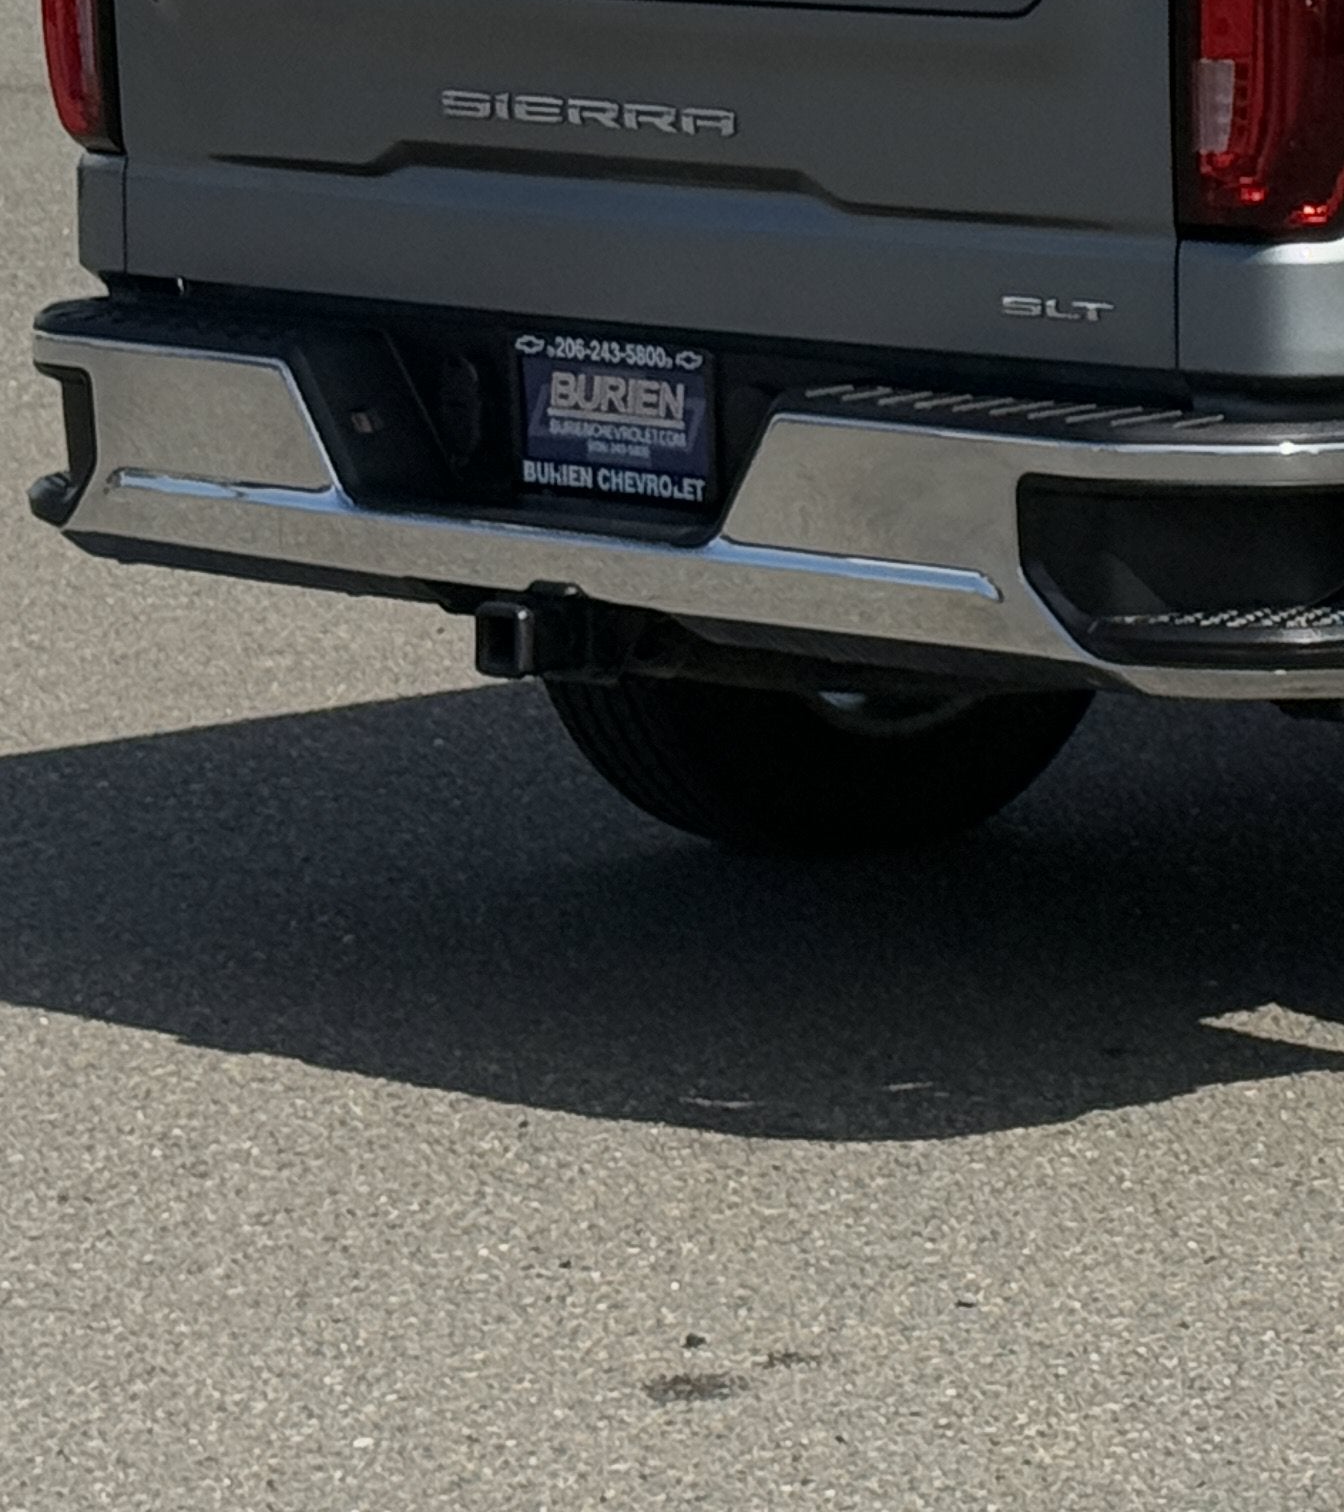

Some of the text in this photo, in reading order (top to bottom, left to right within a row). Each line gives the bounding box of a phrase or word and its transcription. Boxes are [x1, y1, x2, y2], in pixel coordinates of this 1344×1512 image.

[441, 89, 738, 137] SIERRA
[1002, 296, 1115, 321] SLT
[552, 371, 686, 419] BURIEN
